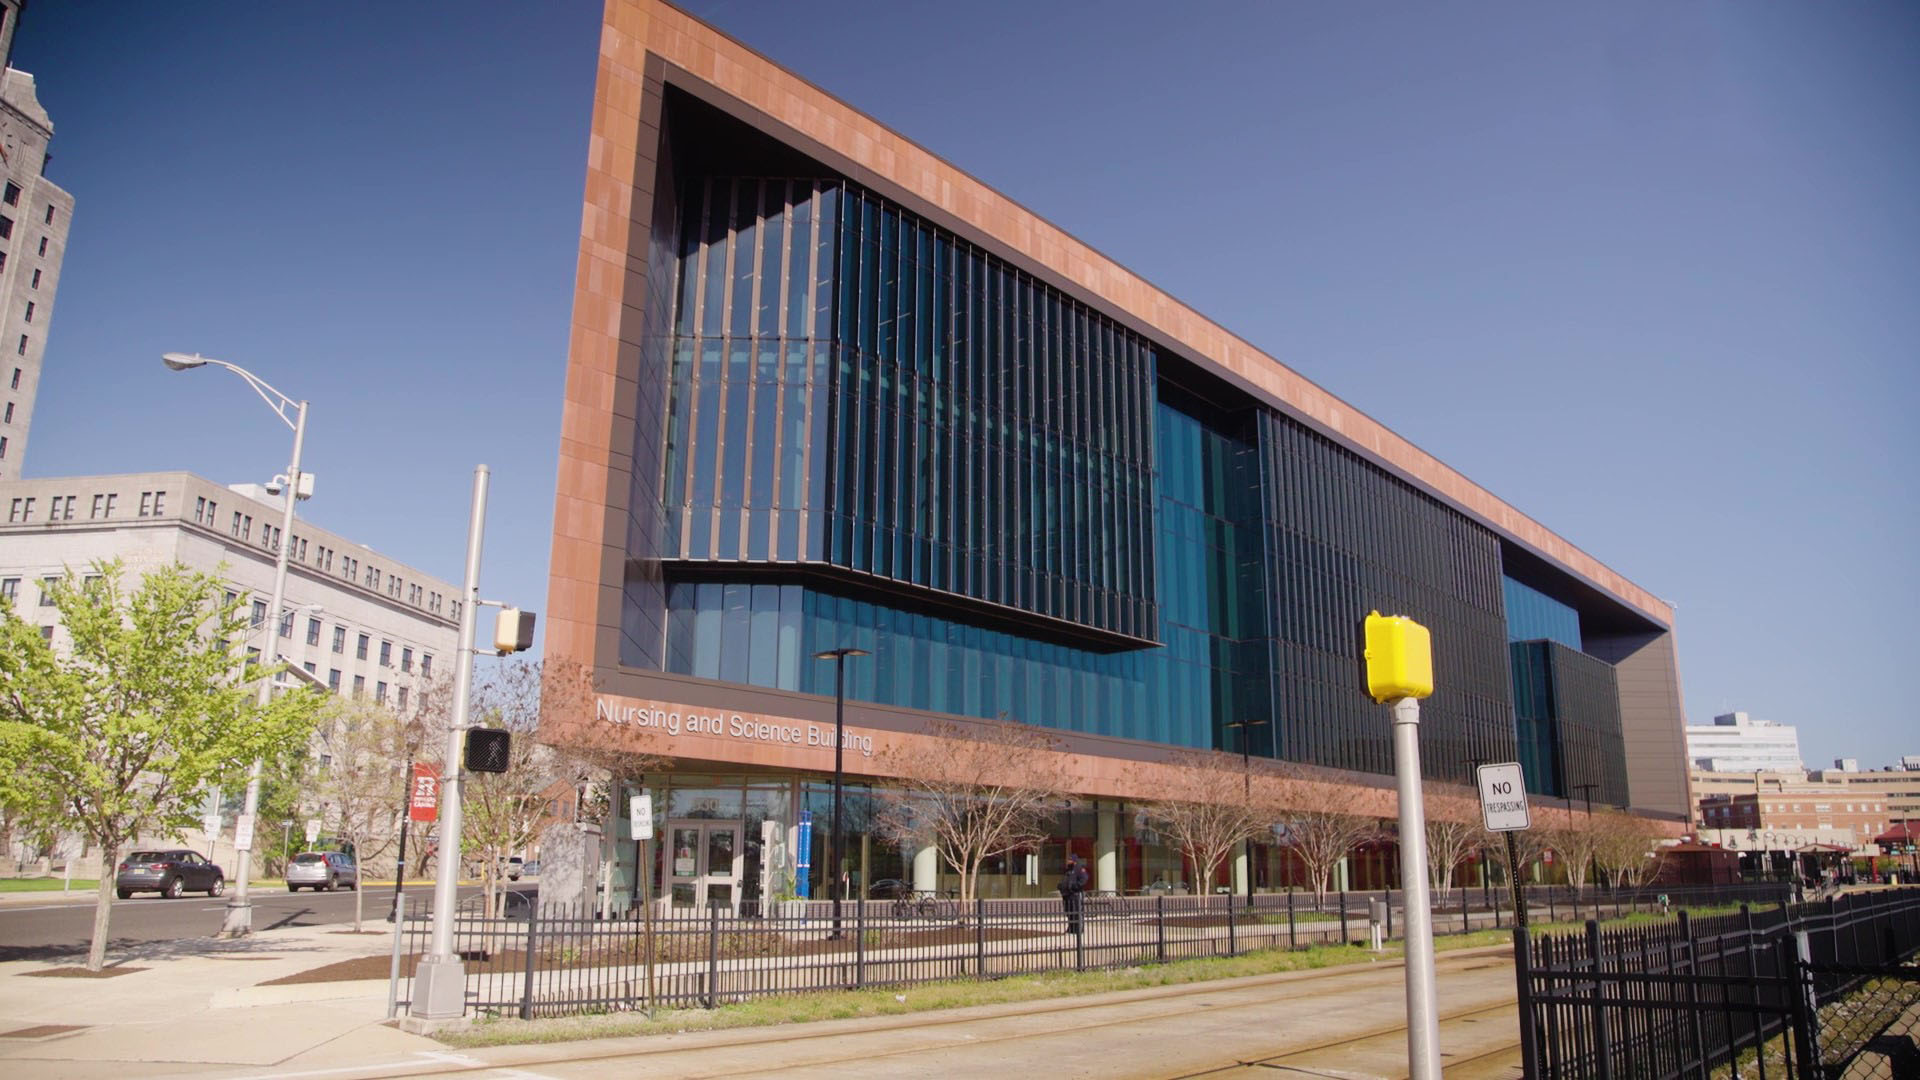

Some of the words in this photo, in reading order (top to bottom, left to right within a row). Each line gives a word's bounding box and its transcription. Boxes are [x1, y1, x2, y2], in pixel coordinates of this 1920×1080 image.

[596, 698, 680, 736] Nursing
[686, 713, 724, 735] and
[729, 715, 801, 743] Science
[807, 725, 873, 756] Building
[1492, 781, 1512, 795] NO
[636, 807, 646, 816] NO
[1486, 800, 1524, 814] TRESPASSING
